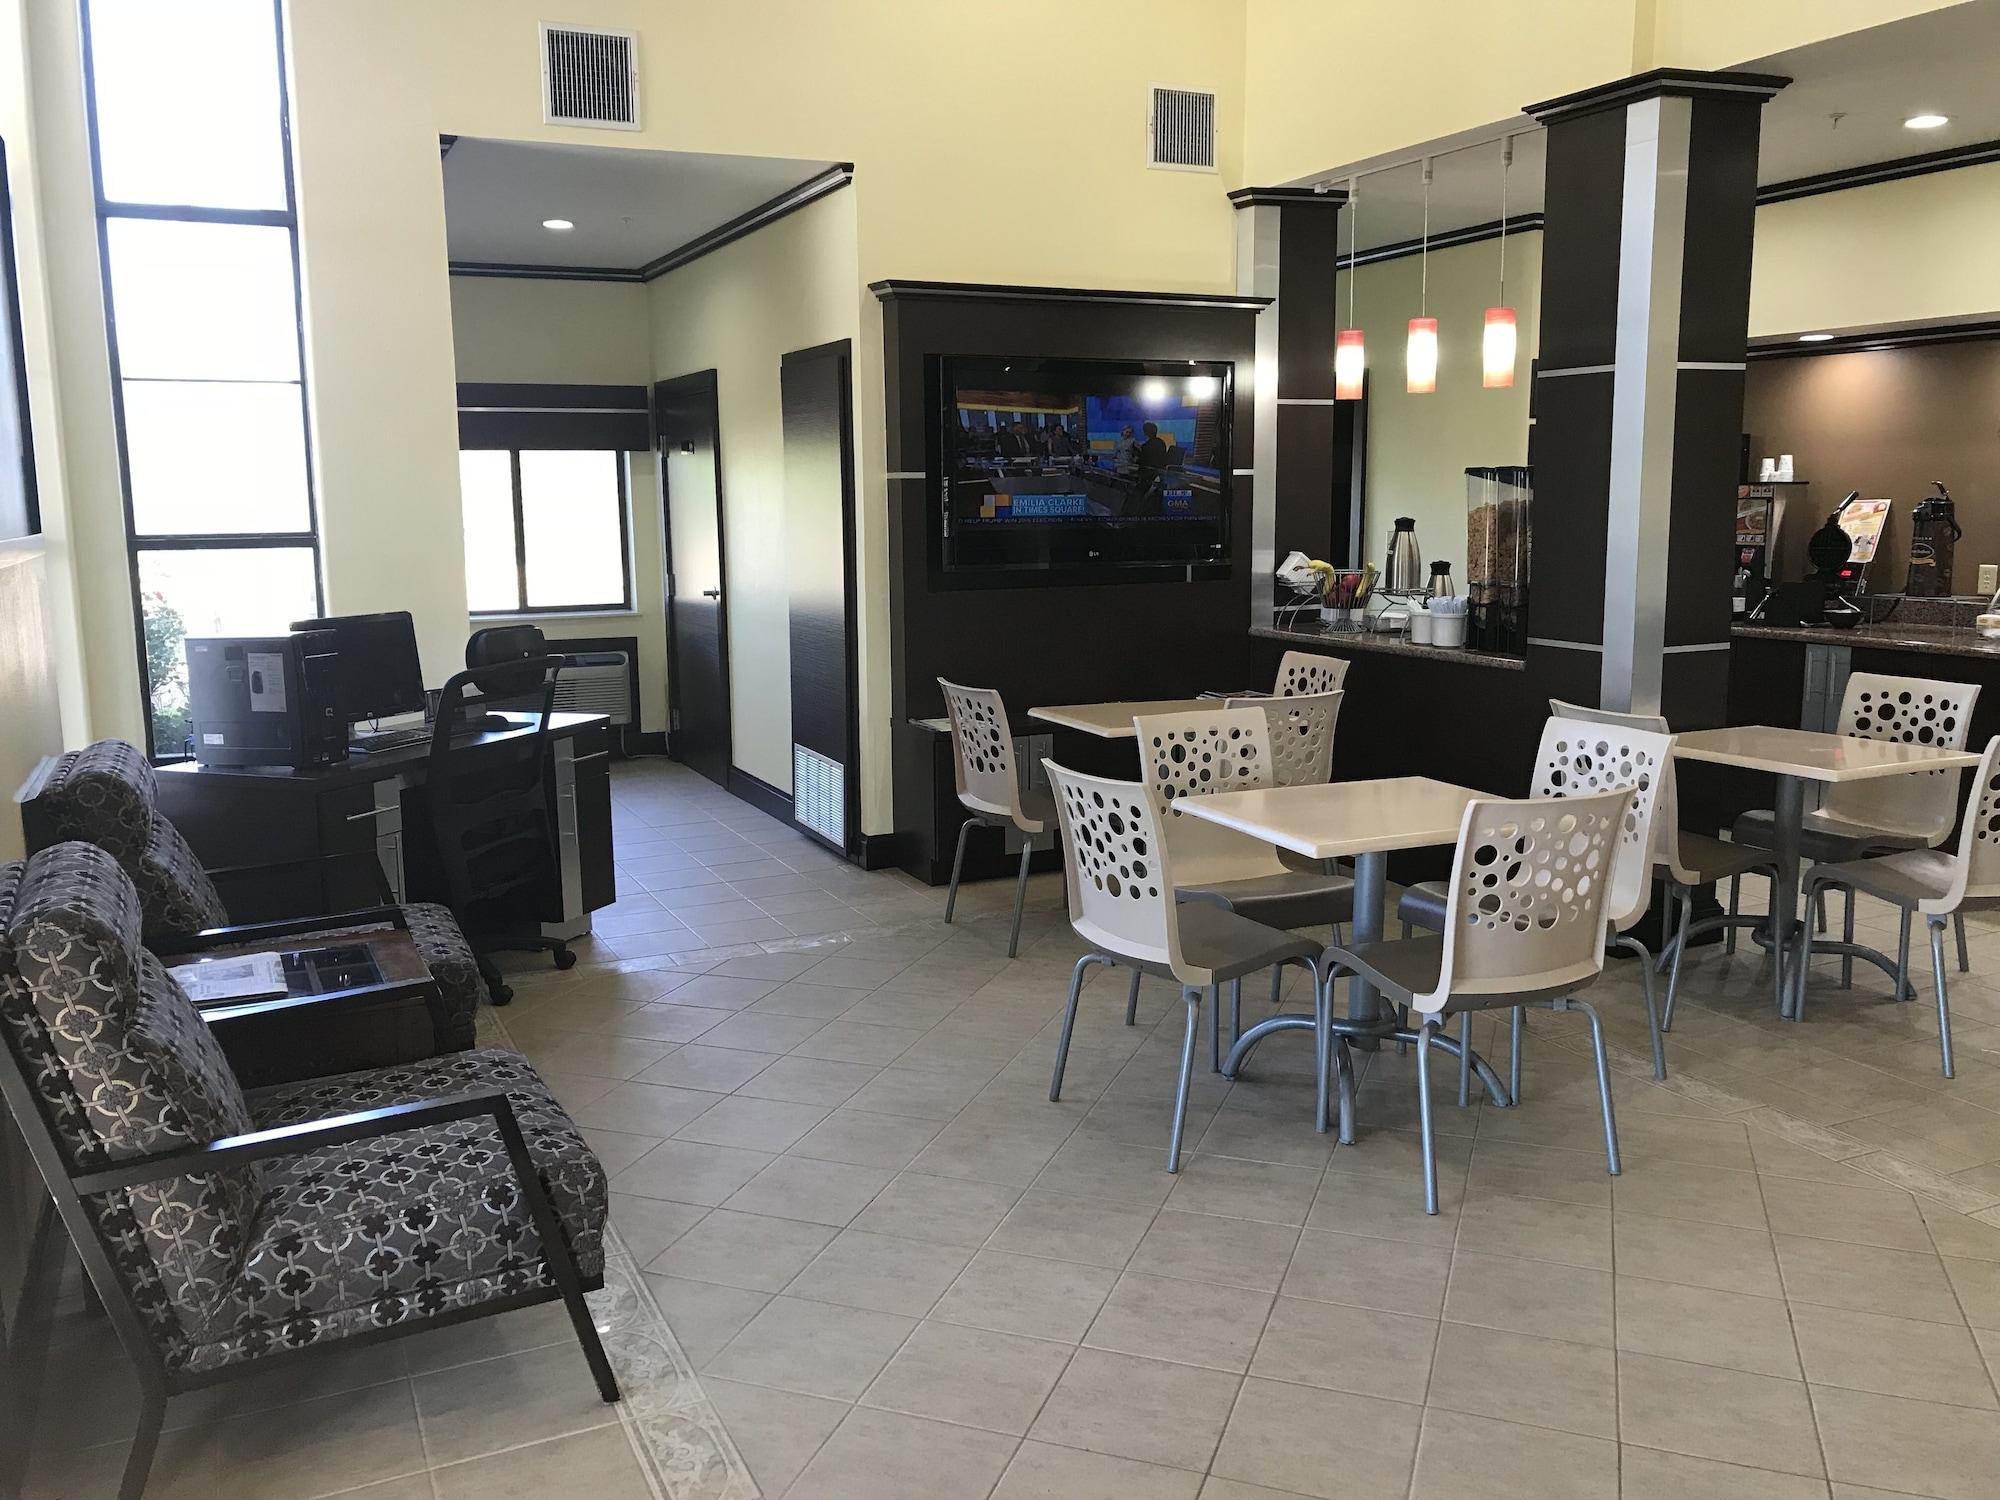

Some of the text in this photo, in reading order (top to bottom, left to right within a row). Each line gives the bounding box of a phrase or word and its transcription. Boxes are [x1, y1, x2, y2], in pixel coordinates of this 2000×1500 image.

[1012, 498, 1084, 506] EMILIA CLARKE
[1167, 499, 1189, 507] GMA
[1013, 506, 1022, 514] IN
[1024, 506, 1048, 514] TIMES
